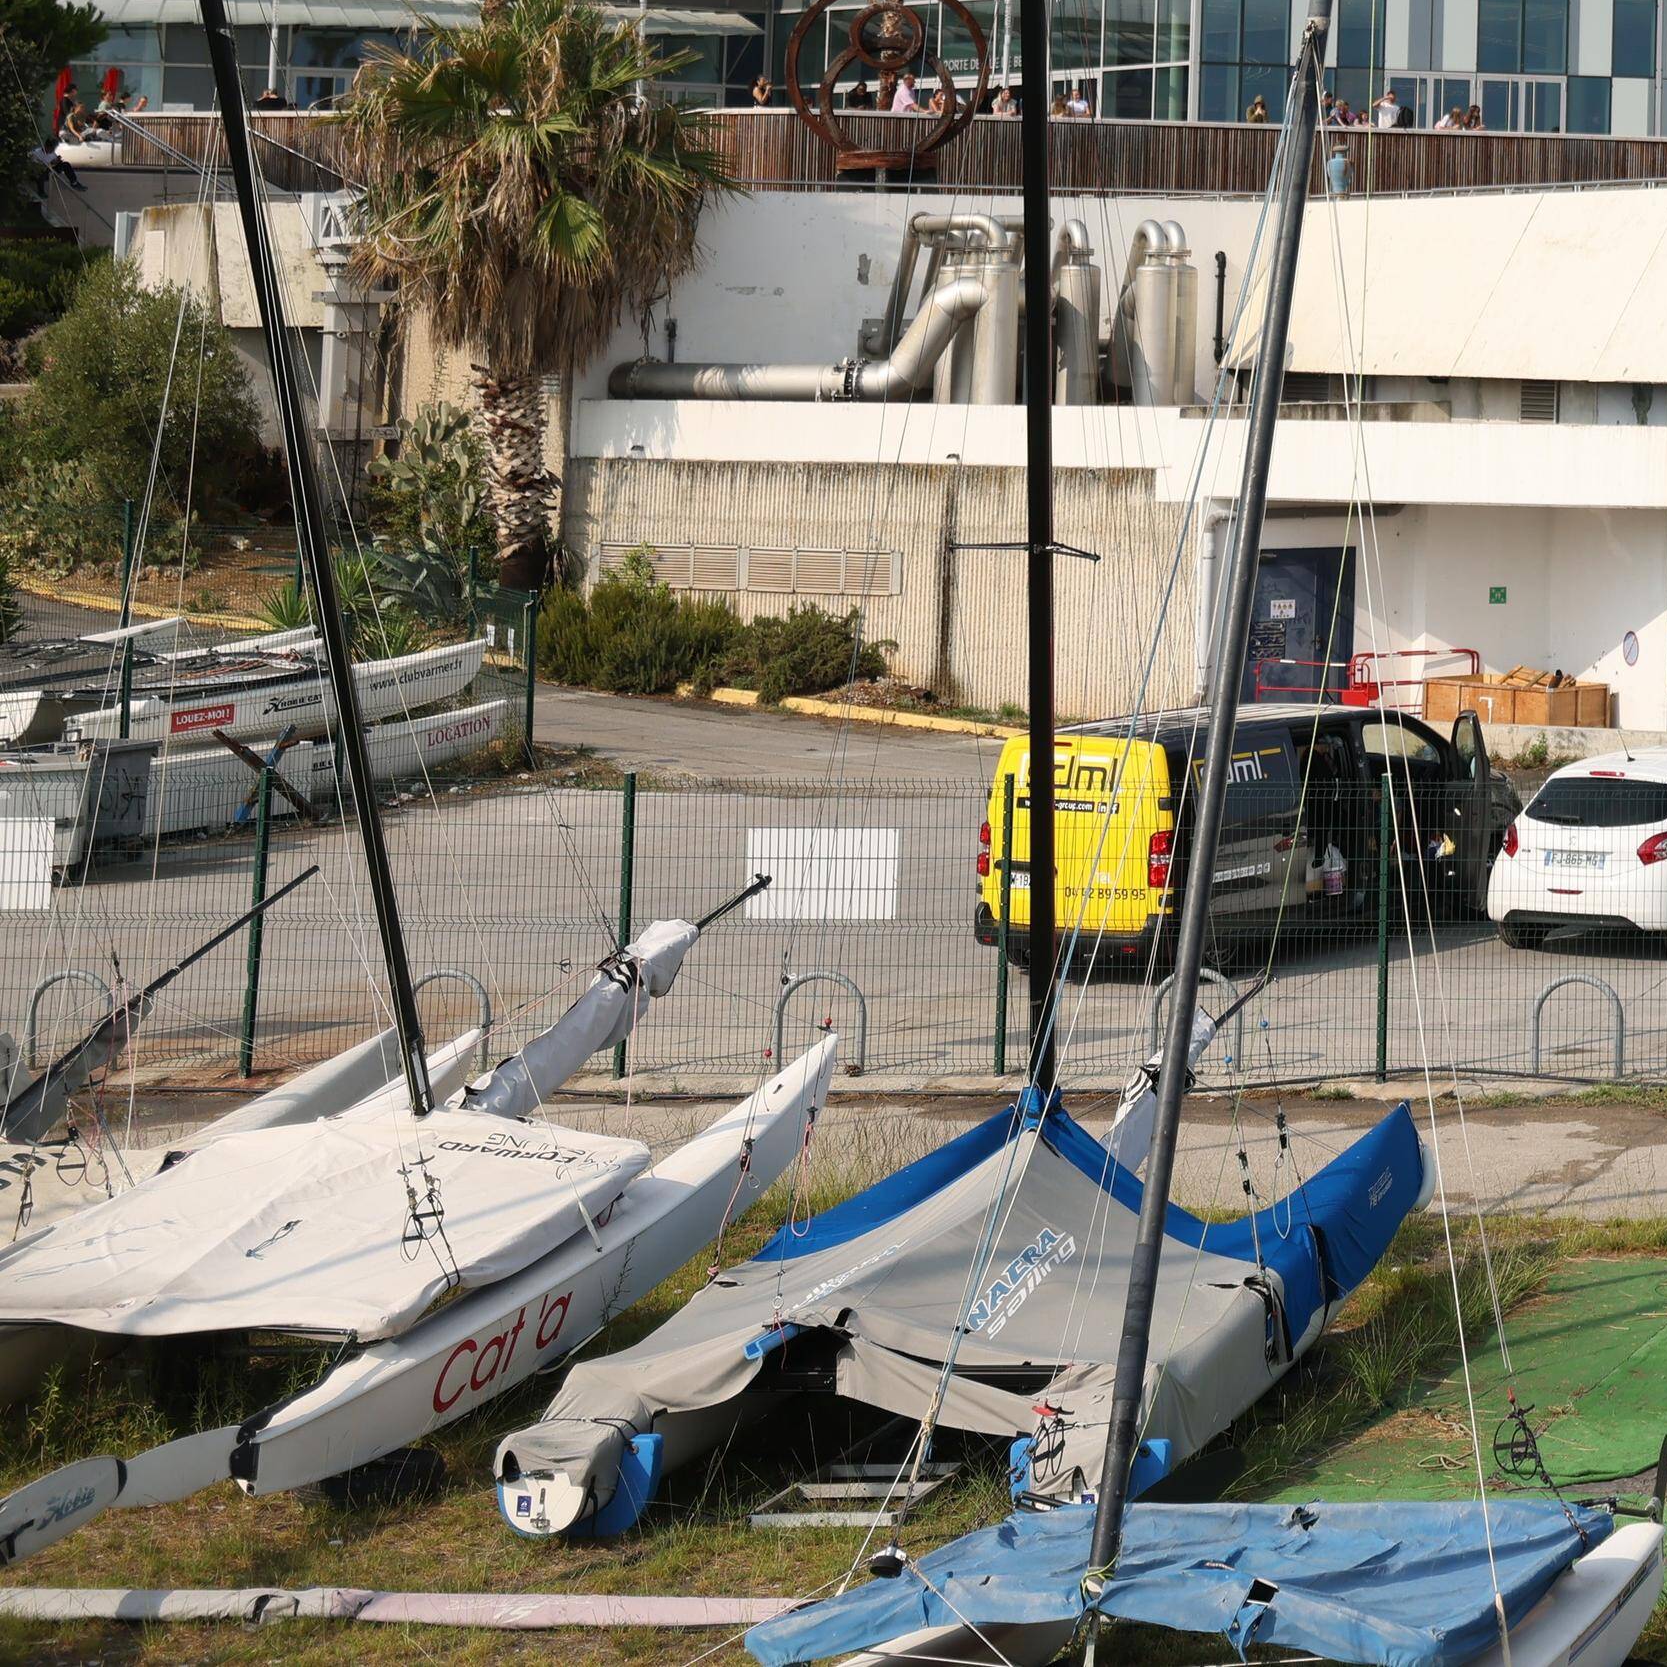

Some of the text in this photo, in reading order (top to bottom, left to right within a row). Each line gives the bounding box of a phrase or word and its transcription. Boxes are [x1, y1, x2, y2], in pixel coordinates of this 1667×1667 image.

[370, 658, 463, 692] www.clubvarmer.fr
[428, 716, 491, 747] LOCATION
[1097, 889, 1111, 900] 89
[1114, 889, 1128, 900] 59
[1131, 889, 1146, 901] 95
[438, 1140, 578, 1164] FORWARD
[987, 1232, 1076, 1340] sailing
[433, 1307, 527, 1413] Cat
